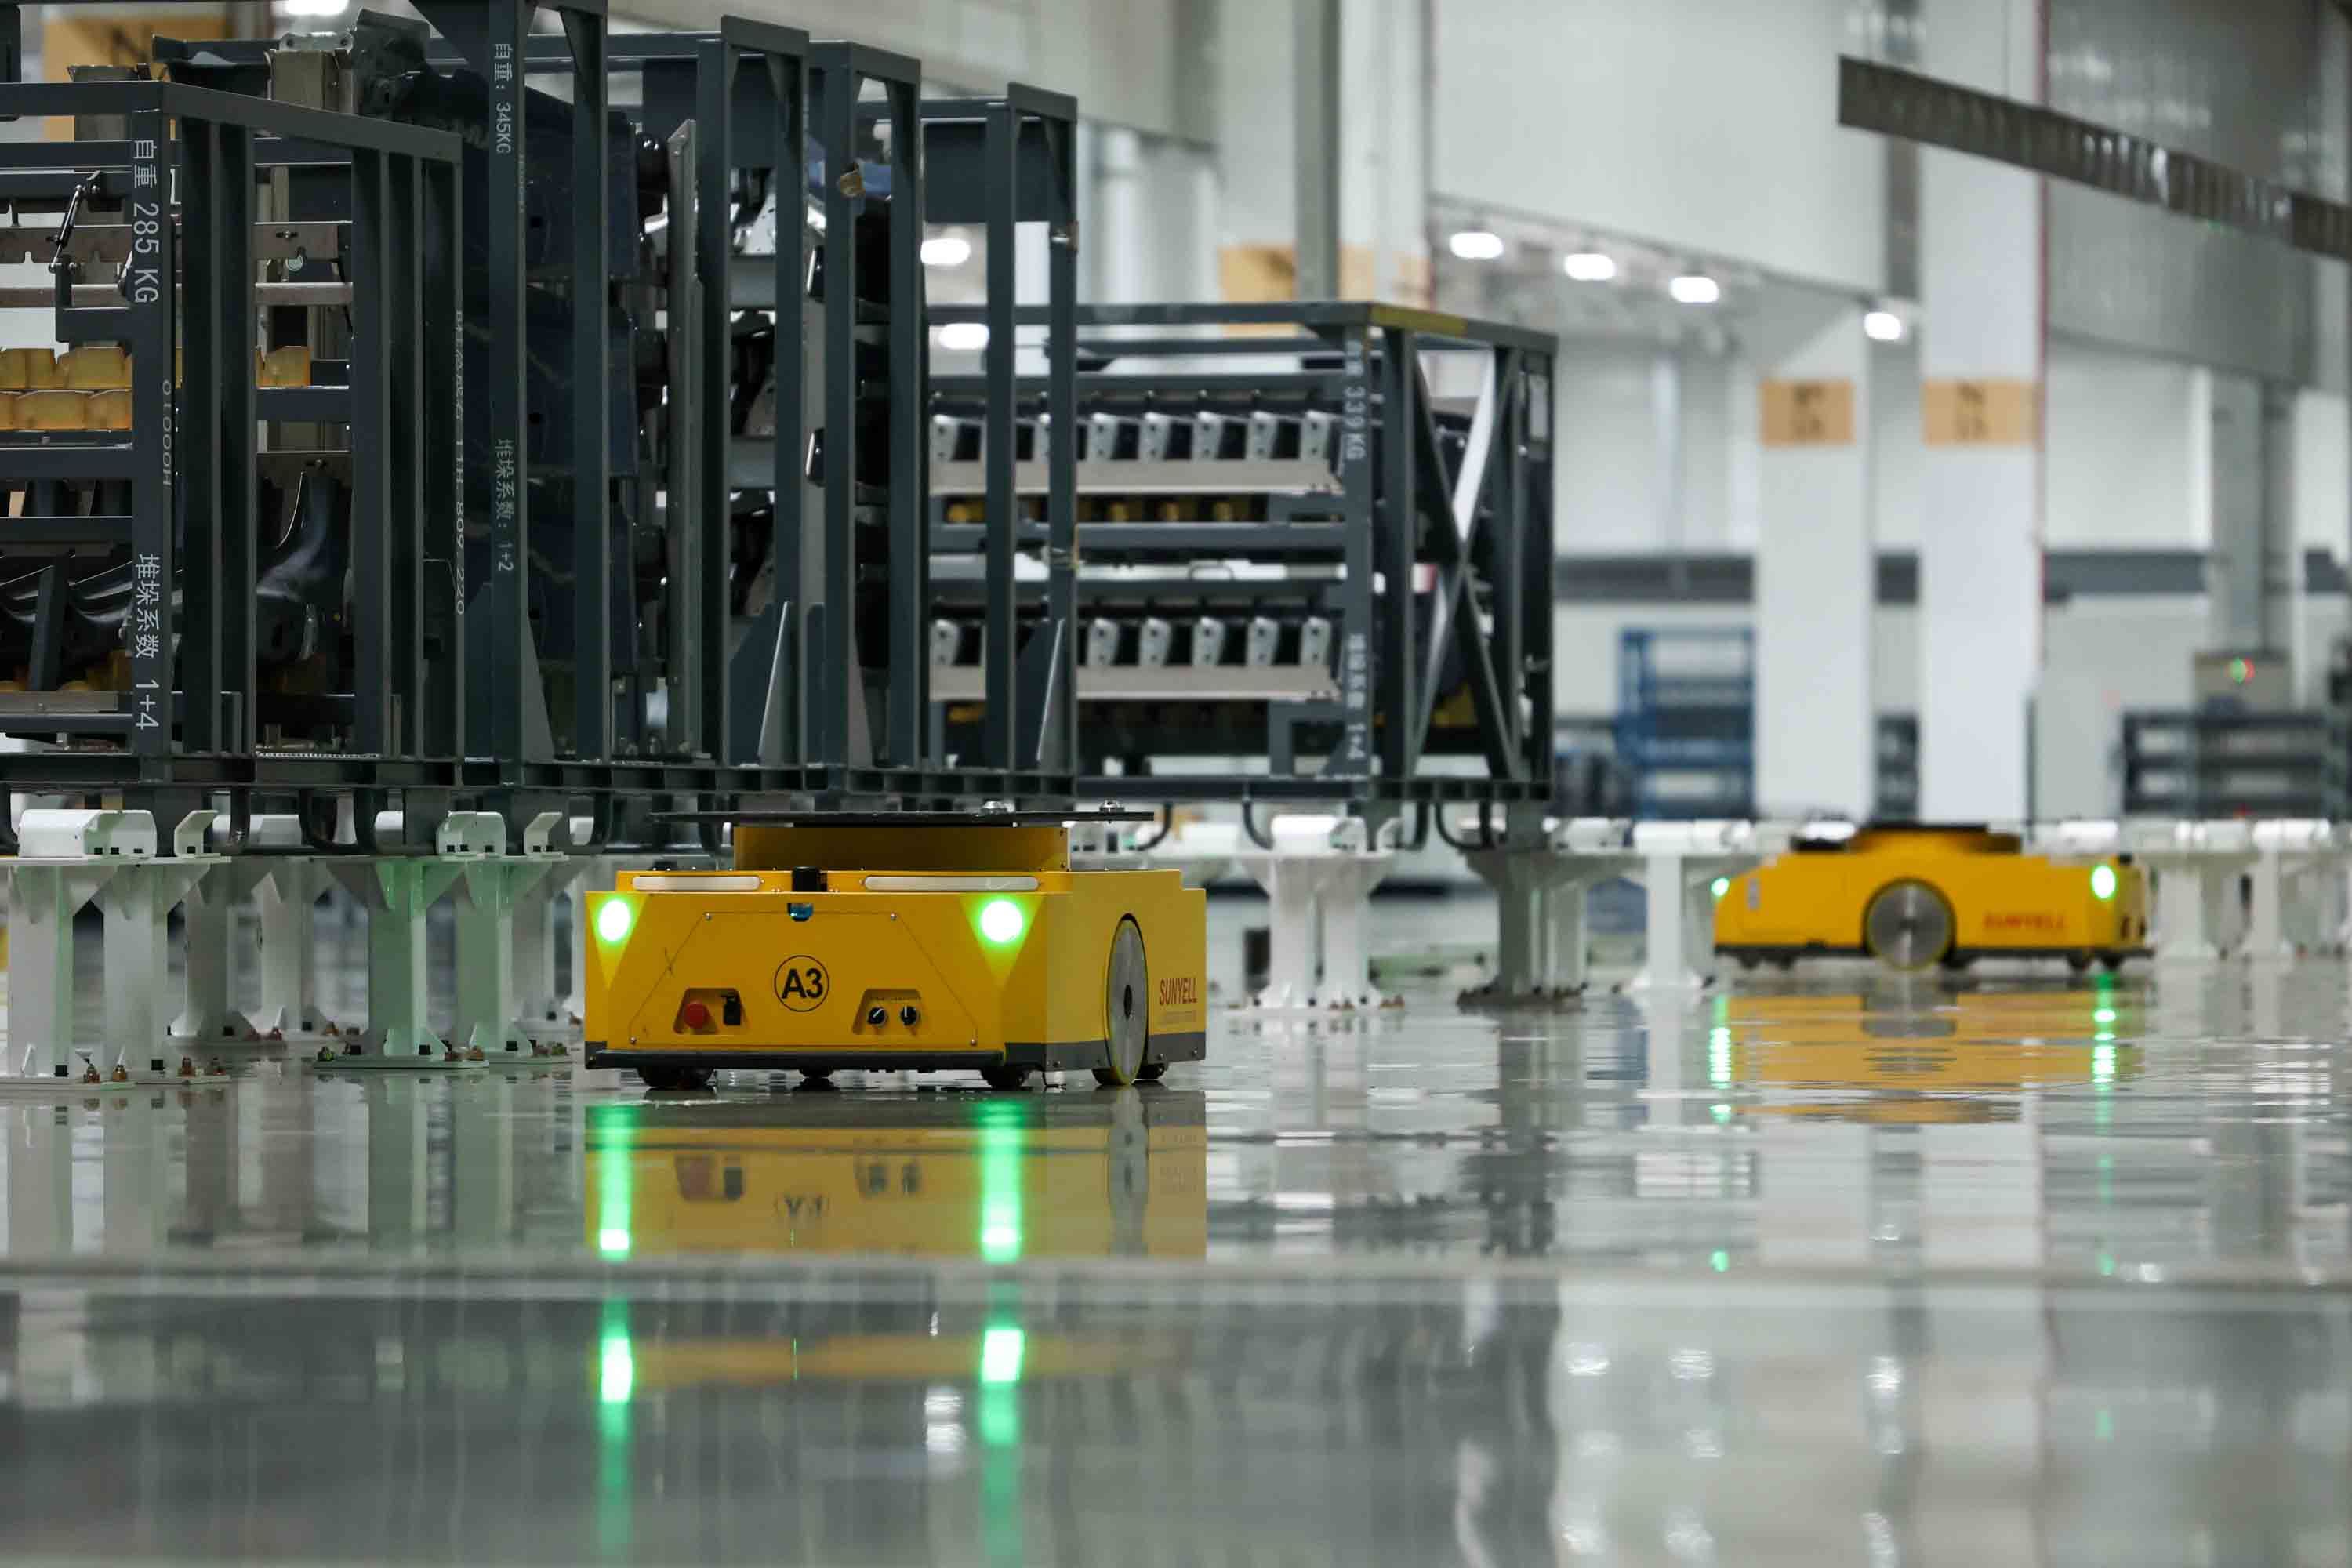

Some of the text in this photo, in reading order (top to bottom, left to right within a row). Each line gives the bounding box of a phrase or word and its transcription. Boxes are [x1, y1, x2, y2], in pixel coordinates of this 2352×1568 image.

[495, 102, 512, 154] 345KG
[133, 139, 159, 304] 自重 285 KG
[497, 542, 514, 572] 1+2
[136, 554, 160, 731] 堆垛系数 1+4
[782, 967, 823, 998] A3
[1160, 978, 1197, 1005] SUNYELL
